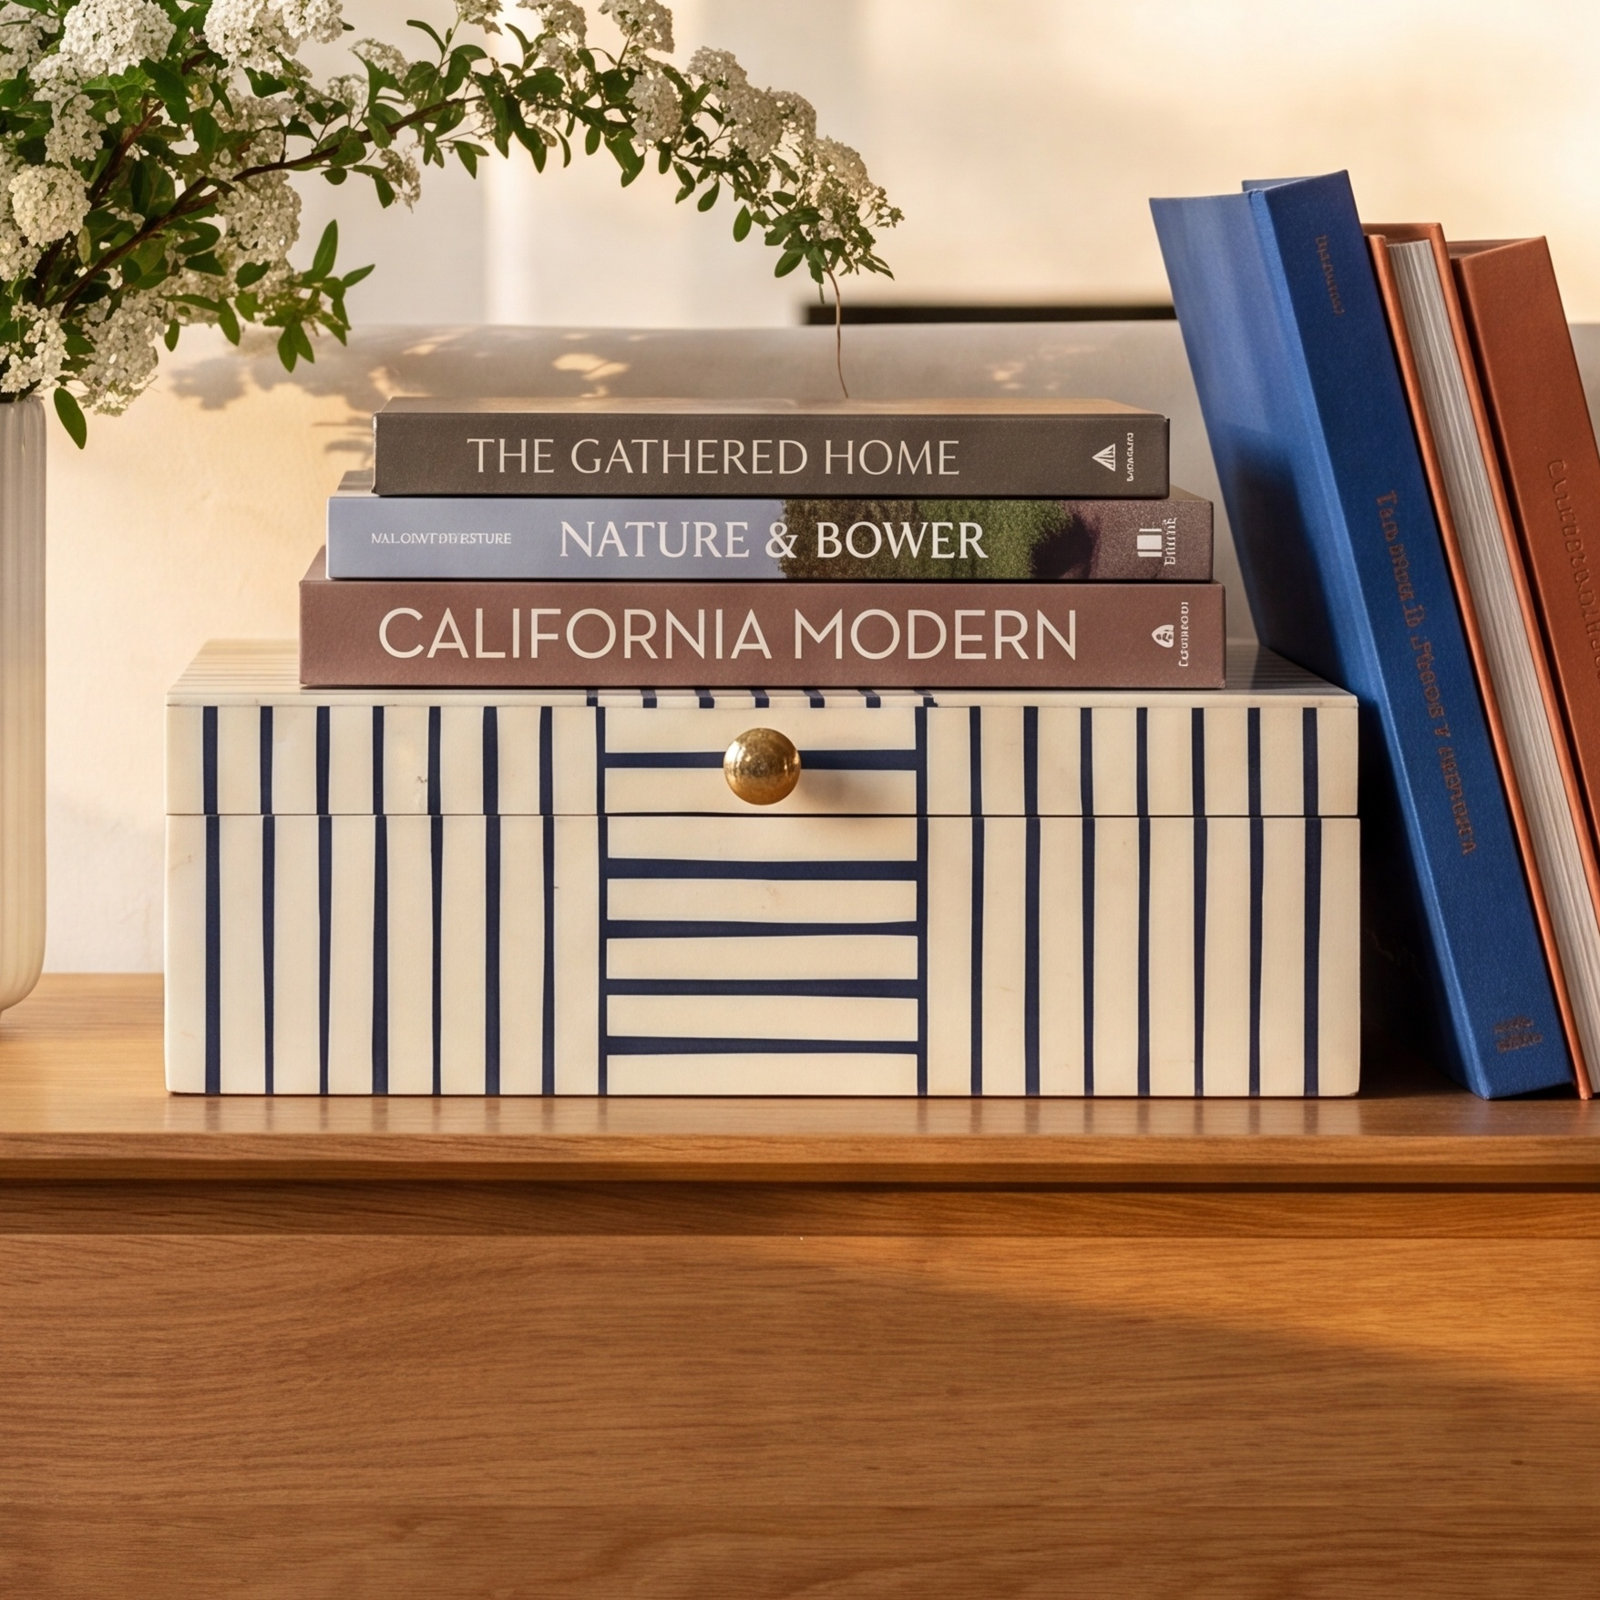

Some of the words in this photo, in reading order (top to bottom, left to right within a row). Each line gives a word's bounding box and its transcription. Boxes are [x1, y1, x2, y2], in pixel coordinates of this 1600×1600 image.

[466, 438, 555, 475] THE
[570, 438, 808, 476] GATHERED
[824, 439, 961, 477] HOME
[560, 520, 750, 558] NATURE
[765, 521, 798, 559] &
[816, 521, 989, 559] BOWER
[377, 607, 772, 661] CALIFORNIA
[795, 607, 1077, 661] MODERN
